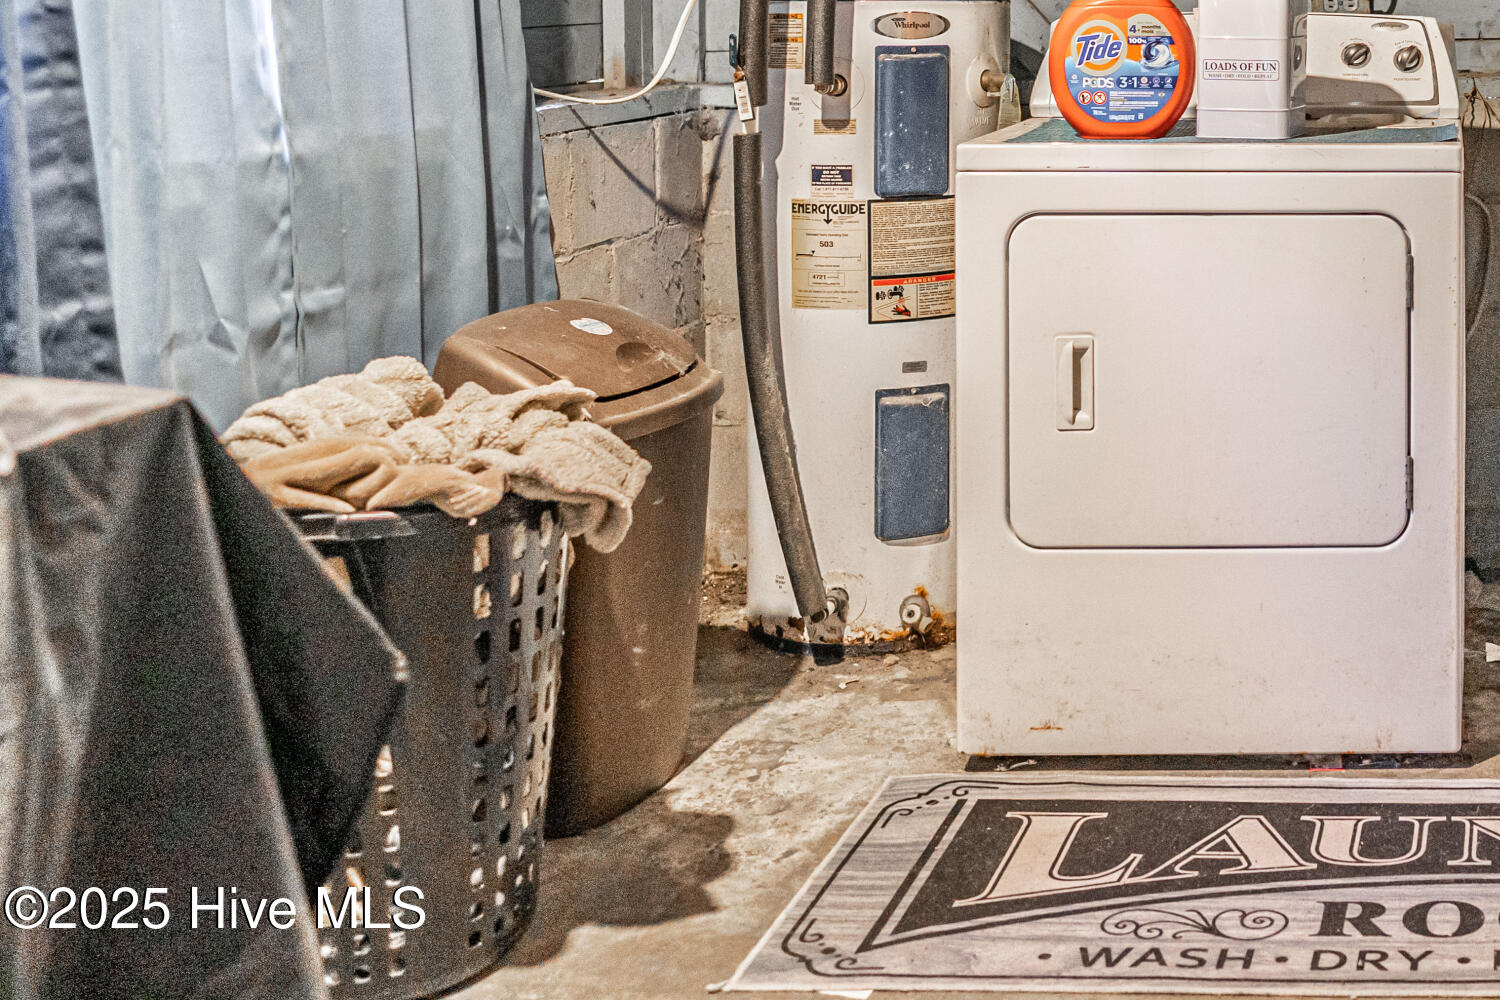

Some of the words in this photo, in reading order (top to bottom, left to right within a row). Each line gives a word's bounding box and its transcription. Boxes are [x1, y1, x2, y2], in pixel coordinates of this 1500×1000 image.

[894, 21, 931, 29] Whirlpool
[1076, 32, 1123, 67] Tide
[1204, 61, 1237, 71] LOADS
[1239, 62, 1254, 71] OF
[1255, 62, 1277, 71] FUN
[1082, 77, 1115, 89] PODS
[792, 203, 866, 216] ENERGYGUIDE
[819, 240, 834, 248] 503
[1078, 946, 1255, 970] WASH
[1309, 948, 1435, 972] DRY
